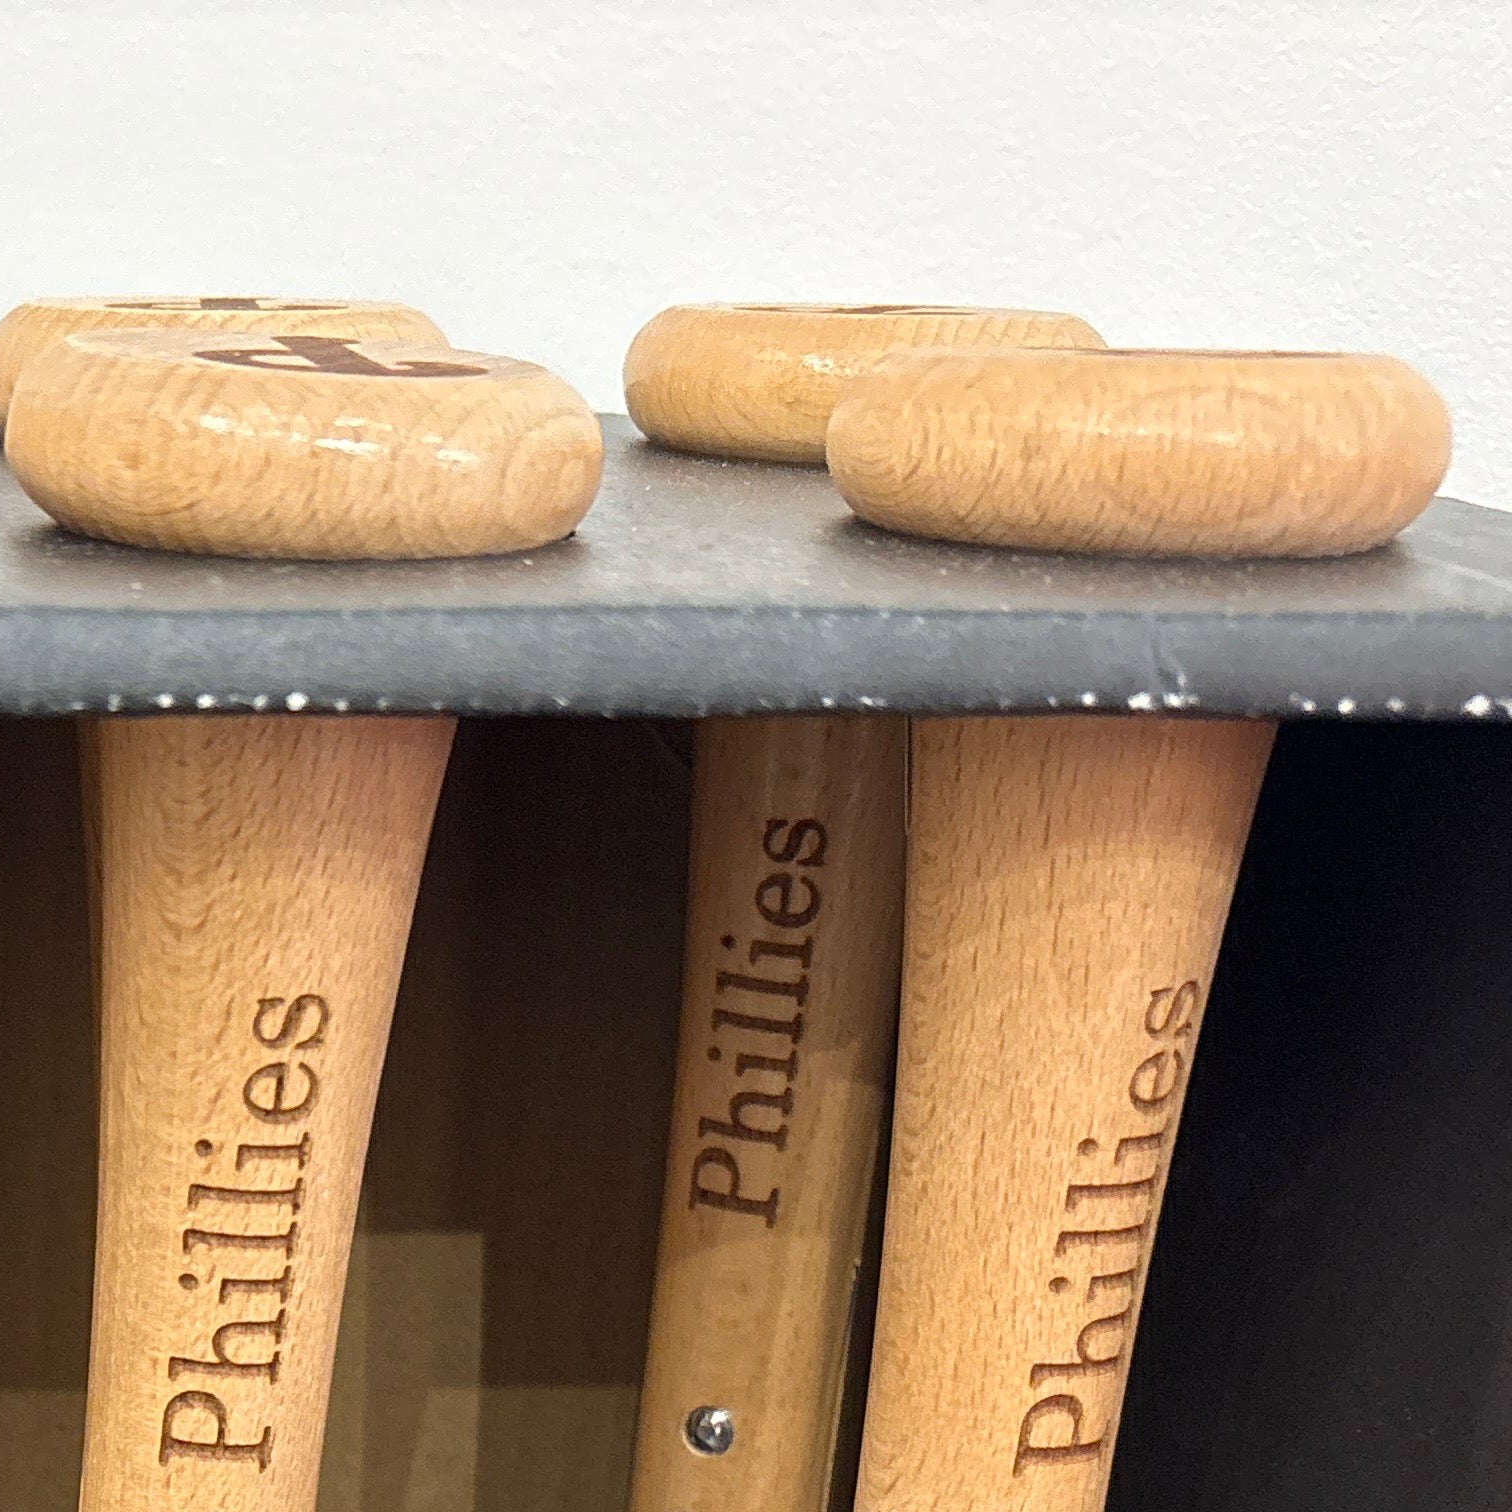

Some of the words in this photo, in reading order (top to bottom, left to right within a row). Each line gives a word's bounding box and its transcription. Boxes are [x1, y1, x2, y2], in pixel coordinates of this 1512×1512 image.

[158, 993, 332, 1473] Phillies
[690, 815, 827, 1227] Phillies
[1012, 978, 1201, 1478] Phillies
